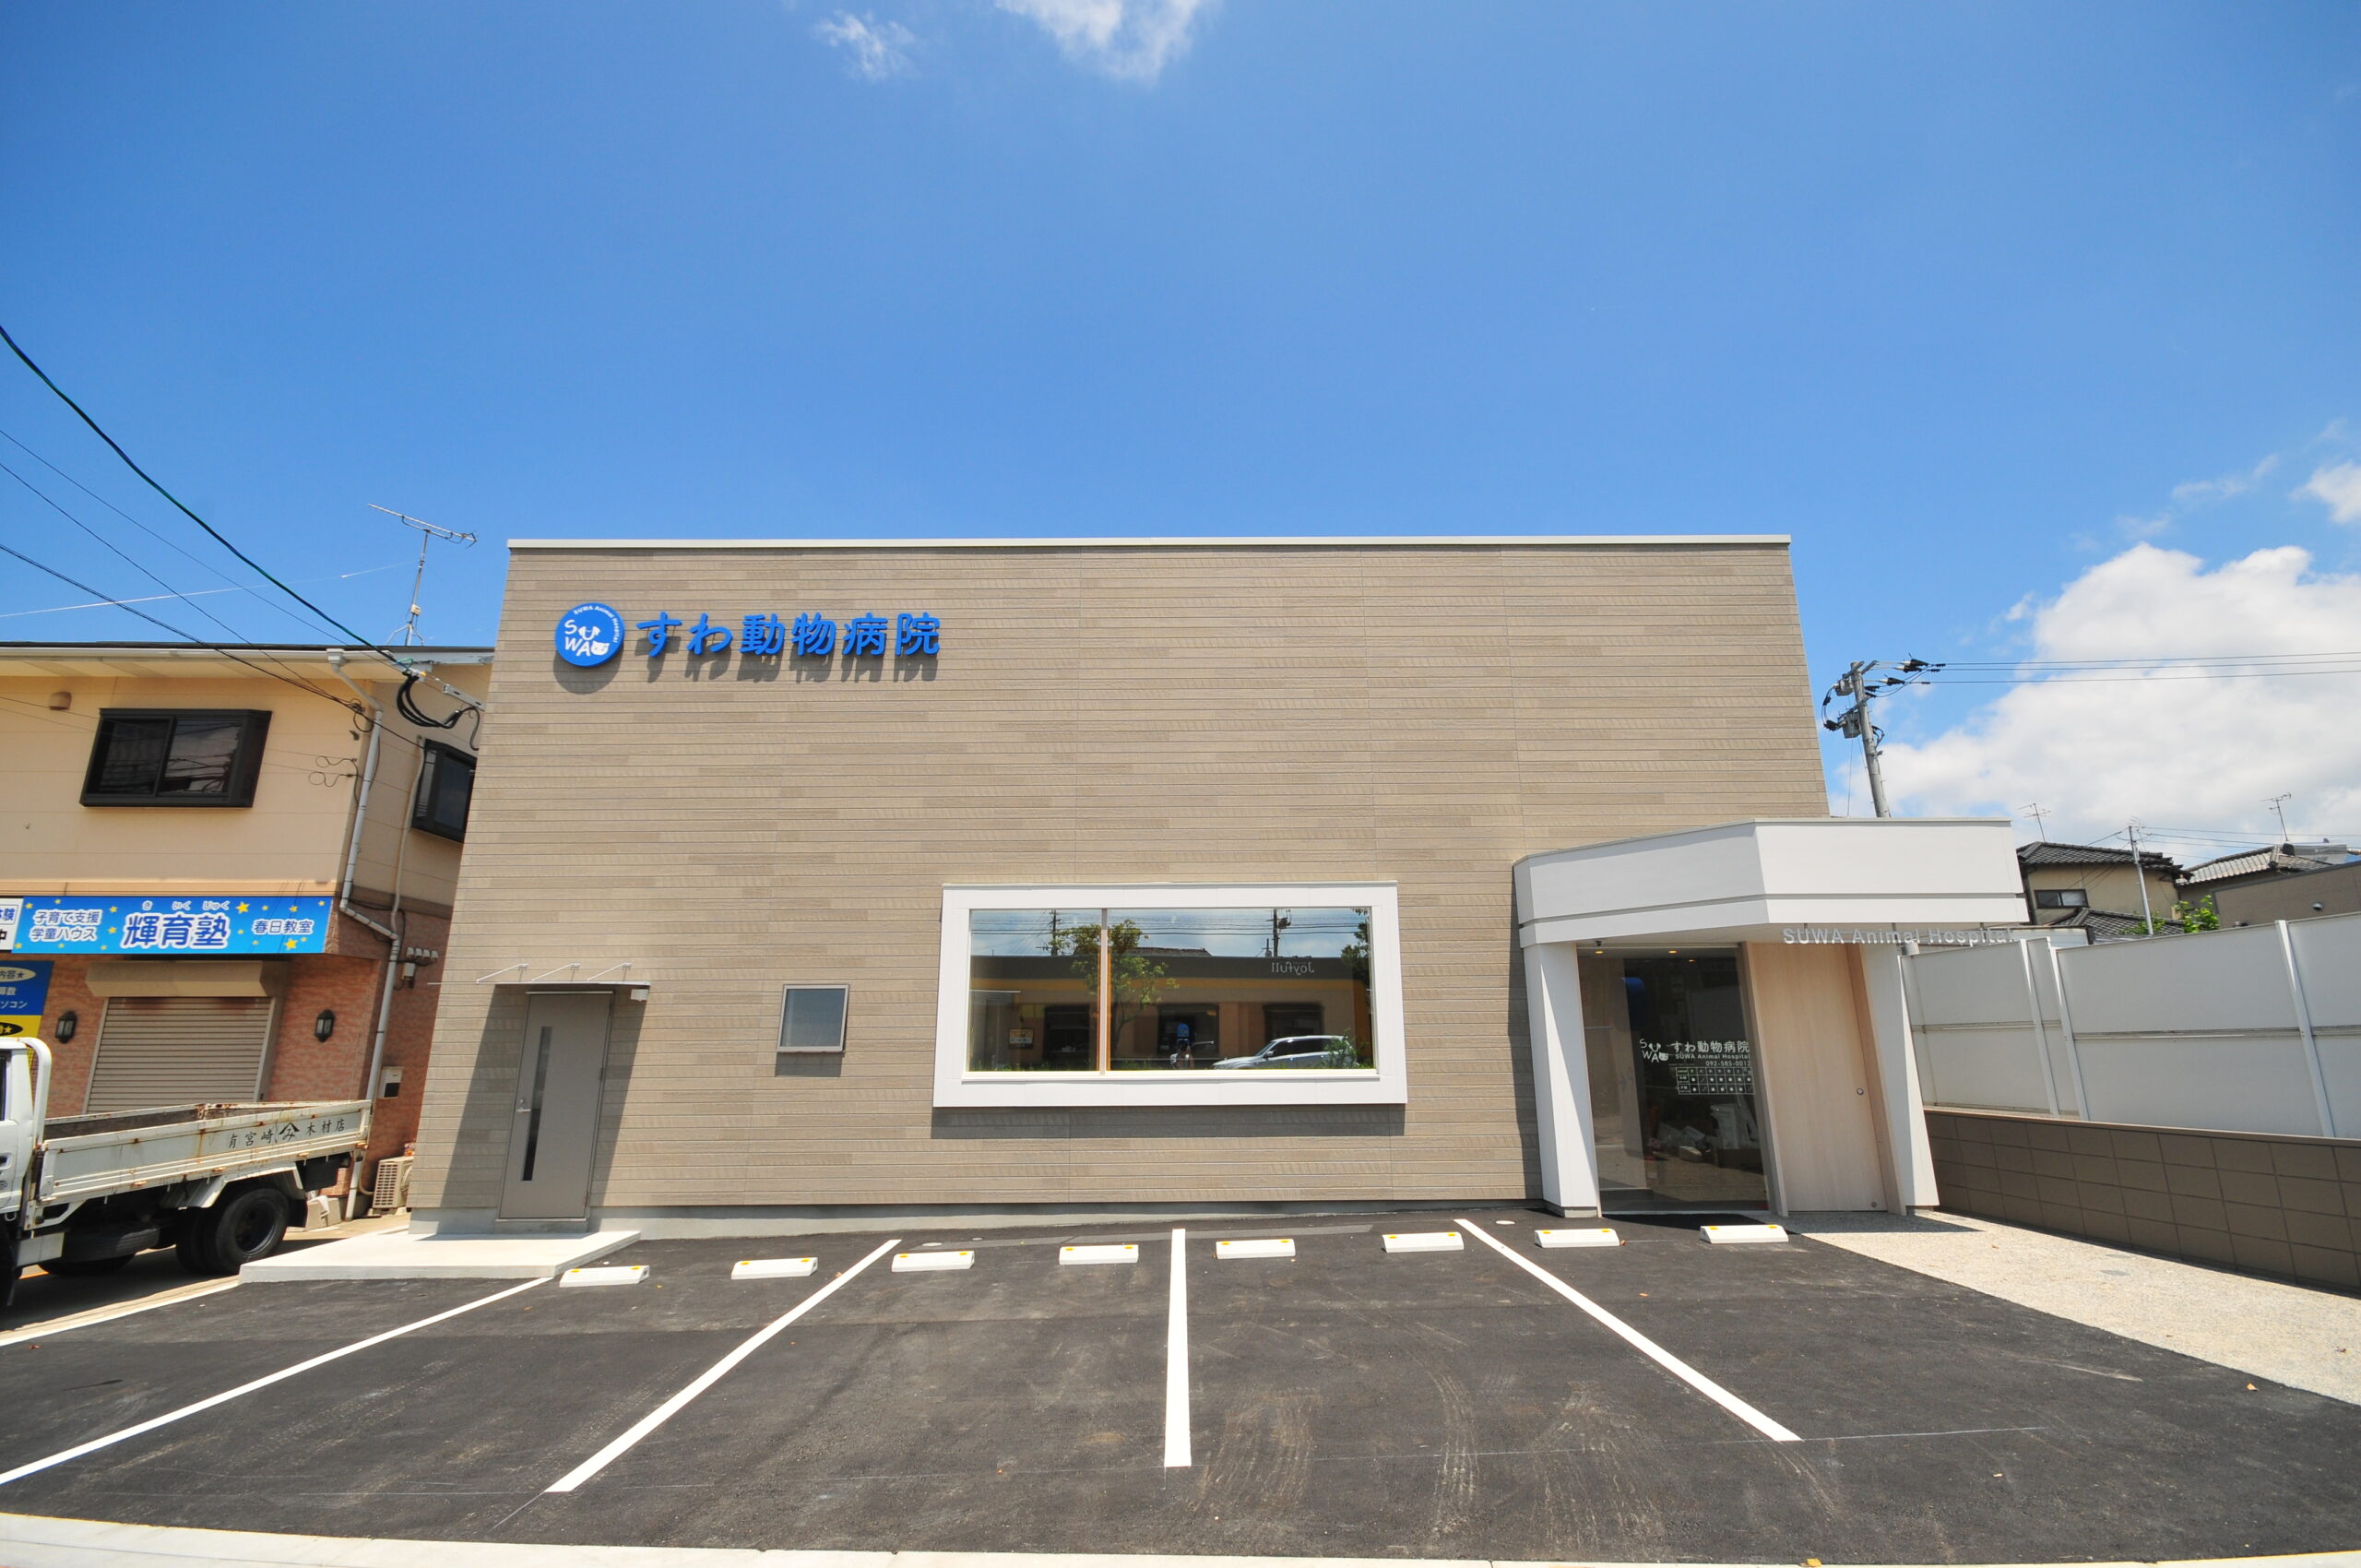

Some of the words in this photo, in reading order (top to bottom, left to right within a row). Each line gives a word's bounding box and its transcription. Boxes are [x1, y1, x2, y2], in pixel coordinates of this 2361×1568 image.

[635, 612, 940, 657] すわ動物病院
[0, 909, 15, 921] 験
[34, 910, 101, 923] 子育て支援
[124, 914, 228, 945] 輝育塾
[254, 921, 313, 933] 春日教室
[31, 928, 95, 940] 学童ハウス
[1783, 929, 1844, 944] SUWA
[1852, 929, 1920, 944] Animal
[1928, 928, 2013, 947] Hospital
[1674, 1040, 1750, 1052] すわ動物病院
